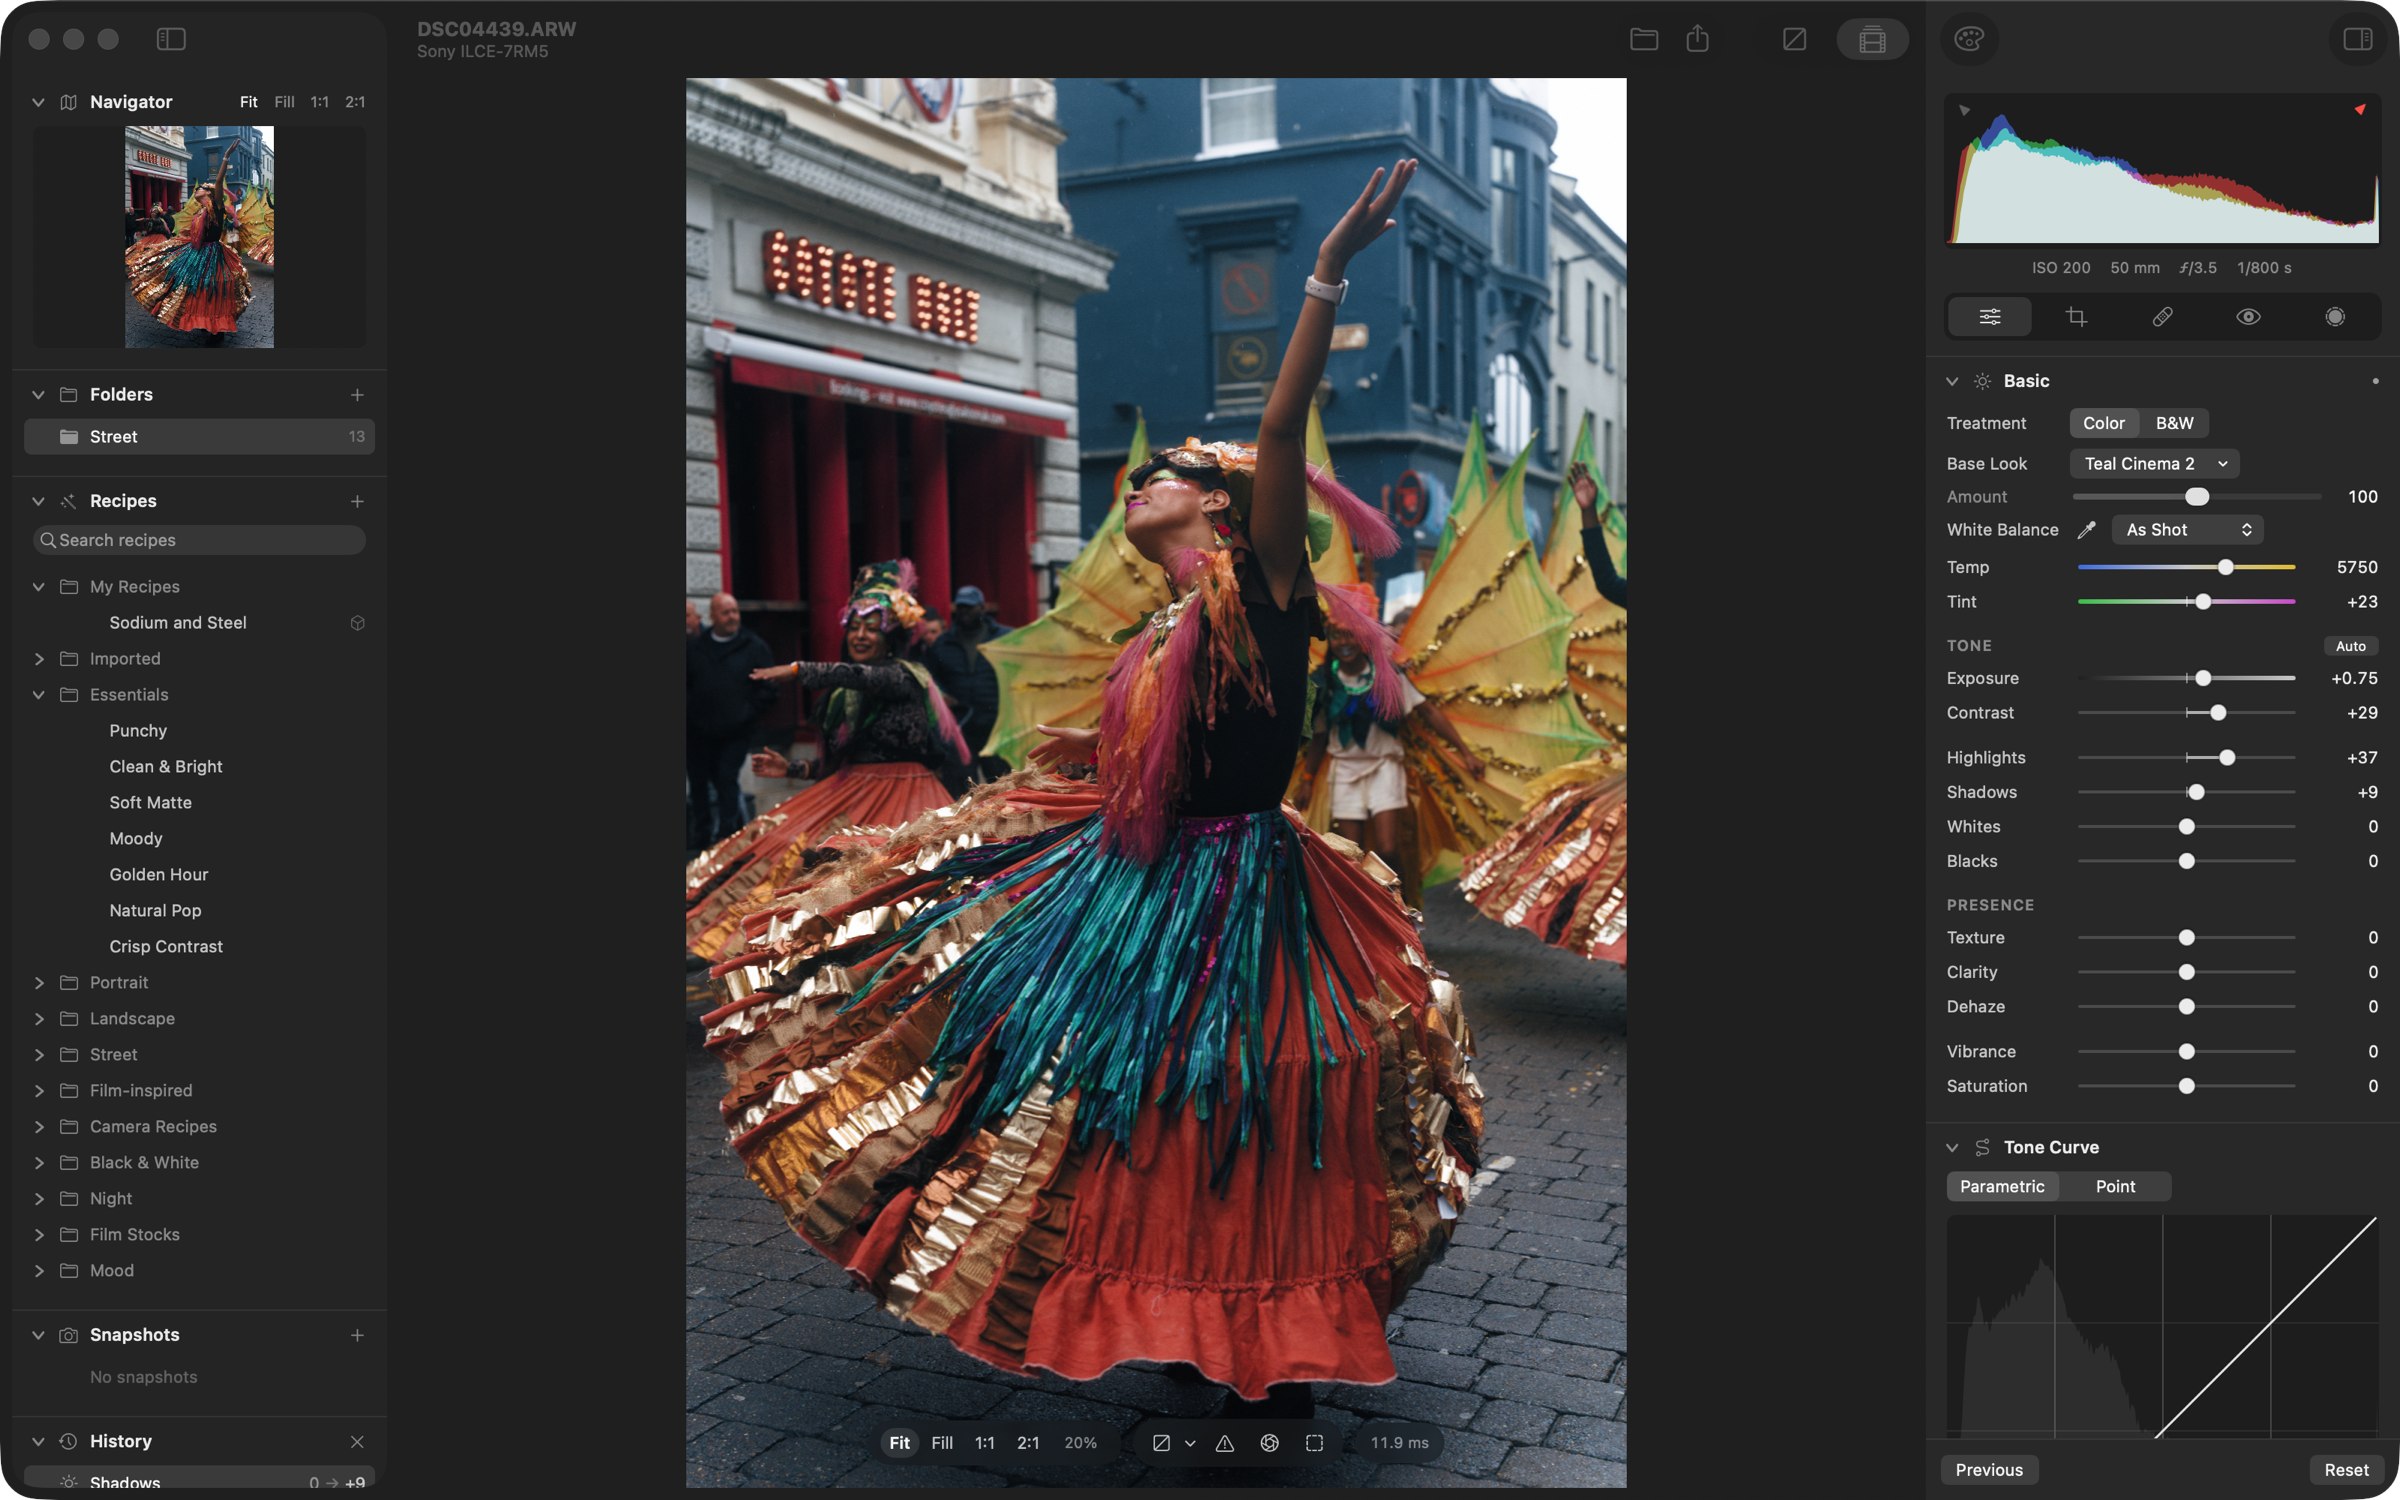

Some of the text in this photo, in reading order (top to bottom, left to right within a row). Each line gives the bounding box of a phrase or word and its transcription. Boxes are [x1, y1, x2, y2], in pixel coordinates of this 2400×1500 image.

[417, 20, 577, 38] DSC04439.ARW
[417, 44, 549, 61] Sony ILCE-7RM5
[90, 93, 174, 112] Navigator
[240, 95, 259, 109] Fit
[274, 95, 295, 109] Fill
[310, 95, 329, 108] 1:1
[345, 95, 365, 109] 2:1
[2032, 261, 2091, 274] ISO 200
[2110, 261, 2160, 274] 50 mm
[2237, 260, 2292, 277] 1/800 s
[2004, 372, 2050, 388] Basic
[90, 386, 154, 402] Folders
[1946, 416, 2027, 430] Treatment
[2083, 415, 2126, 430] Color
[2156, 415, 2195, 430] B&W
[90, 429, 138, 444] Street
[348, 429, 366, 443] 13
[1947, 456, 2028, 471] Base Look
[2084, 456, 2195, 471] Teal Cinema 2
[90, 492, 157, 511] Recipes
[1946, 489, 2008, 504] Amount
[2348, 489, 2379, 504] 100
[1946, 522, 2060, 537] White Balance
[2126, 522, 2188, 537] As Shot
[59, 532, 177, 550] Search recipes
[1946, 560, 1990, 577] Temp
[2337, 559, 2379, 574] 5750
[90, 579, 181, 597] My Recipes
[1946, 594, 1978, 609] Tint
[2347, 594, 2379, 609] +23
[109, 615, 247, 630] Sodium and Steel
[1946, 639, 1992, 652] TONE
[2335, 640, 2367, 652] Auto
[90, 651, 161, 669] Imported
[1947, 671, 2020, 688] Exposure
[2331, 670, 2379, 685] +0.75
[90, 687, 169, 702] Essentials
[1947, 705, 2015, 720] Contrast
[2347, 705, 2379, 720] +29
[110, 723, 168, 741] Punchy
[1947, 750, 2027, 768] Highlights
[2347, 750, 2378, 765] +37
[109, 759, 223, 777] Clean & Bright
[1947, 784, 2018, 799] Shadows
[2358, 785, 2379, 799] +9
[109, 795, 193, 810] Soft Matte
[1946, 819, 2001, 834] Whites
[2368, 819, 2379, 834] 0
[110, 831, 163, 849] Moody
[1947, 853, 1998, 868] Blacks
[2368, 853, 2379, 868] 0
[109, 867, 210, 882] Golden Hour
[110, 903, 202, 921] Natural Pop
[1947, 898, 2034, 912] PRESENCE
[1946, 930, 2006, 945] Texture
[2368, 930, 2379, 945] 0
[109, 939, 224, 957] Crisp Contrast
[1947, 964, 1999, 982] Clarity
[2368, 964, 2379, 979] 0
[90, 975, 149, 990] Portrait
[1947, 999, 2006, 1014] Dehaze
[2368, 999, 2379, 1014] 0
[90, 1011, 176, 1029] Landscape
[90, 1047, 138, 1062] Street
[1946, 1044, 2017, 1059] Vibrance
[2368, 1044, 2379, 1059] 0
[90, 1083, 193, 1101] Film-inspired
[1947, 1078, 2028, 1093] Saturation
[2368, 1078, 2379, 1093] 0
[90, 1119, 218, 1136] Camera Recipes
[2003, 1139, 2100, 1155] Tone Curve
[90, 1155, 200, 1170] Black & White
[1960, 1179, 2046, 1194] Parametric
[2096, 1179, 2137, 1194] Point
[90, 1191, 133, 1209] Night
[90, 1227, 181, 1242] Film Stocks
[90, 1263, 134, 1278] Mood
[90, 1326, 180, 1345] Snapshots
[90, 1369, 198, 1387] No snapshots
[90, 1433, 153, 1452] History
[890, 1435, 911, 1450] Fit
[932, 1435, 953, 1450] Fill
[975, 1436, 994, 1450] 1:1
[1017, 1436, 1039, 1450] 2:1
[1064, 1436, 1098, 1449] 20%
[1371, 1436, 1430, 1449] 11.9 ms
[1956, 1462, 2024, 1477] Previous
[2325, 1463, 2370, 1477] Reset
[90, 1476, 161, 1488] Shadows
[309, 1476, 320, 1488] 0
[345, 1476, 366, 1488] +9
